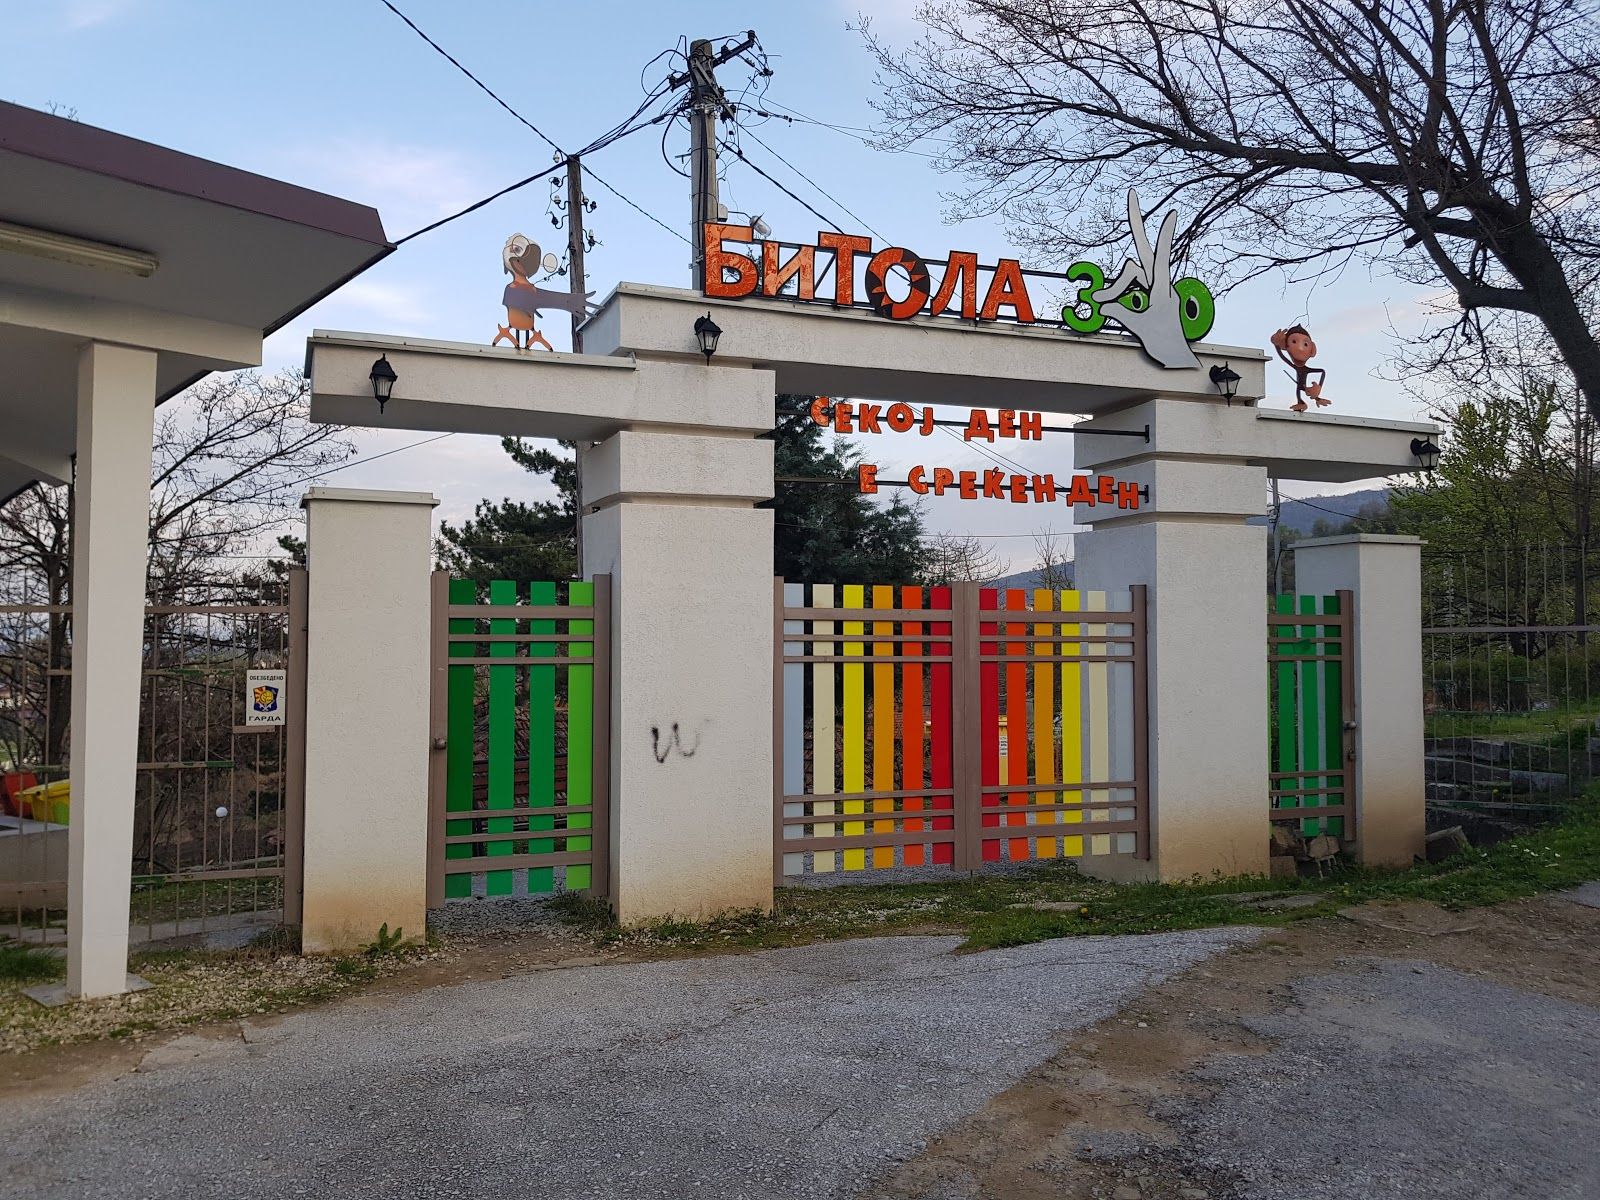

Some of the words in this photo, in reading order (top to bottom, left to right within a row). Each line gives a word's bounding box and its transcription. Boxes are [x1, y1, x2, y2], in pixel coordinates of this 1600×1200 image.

[702, 221, 1037, 324] БИТОЛА
[810, 396, 934, 437] СЕКОЈ
[963, 409, 1042, 443] ДЕН
[858, 464, 878, 494] Е
[908, 465, 1056, 503] СРЕЌЕН
[1066, 475, 1139, 510] ДЕН
